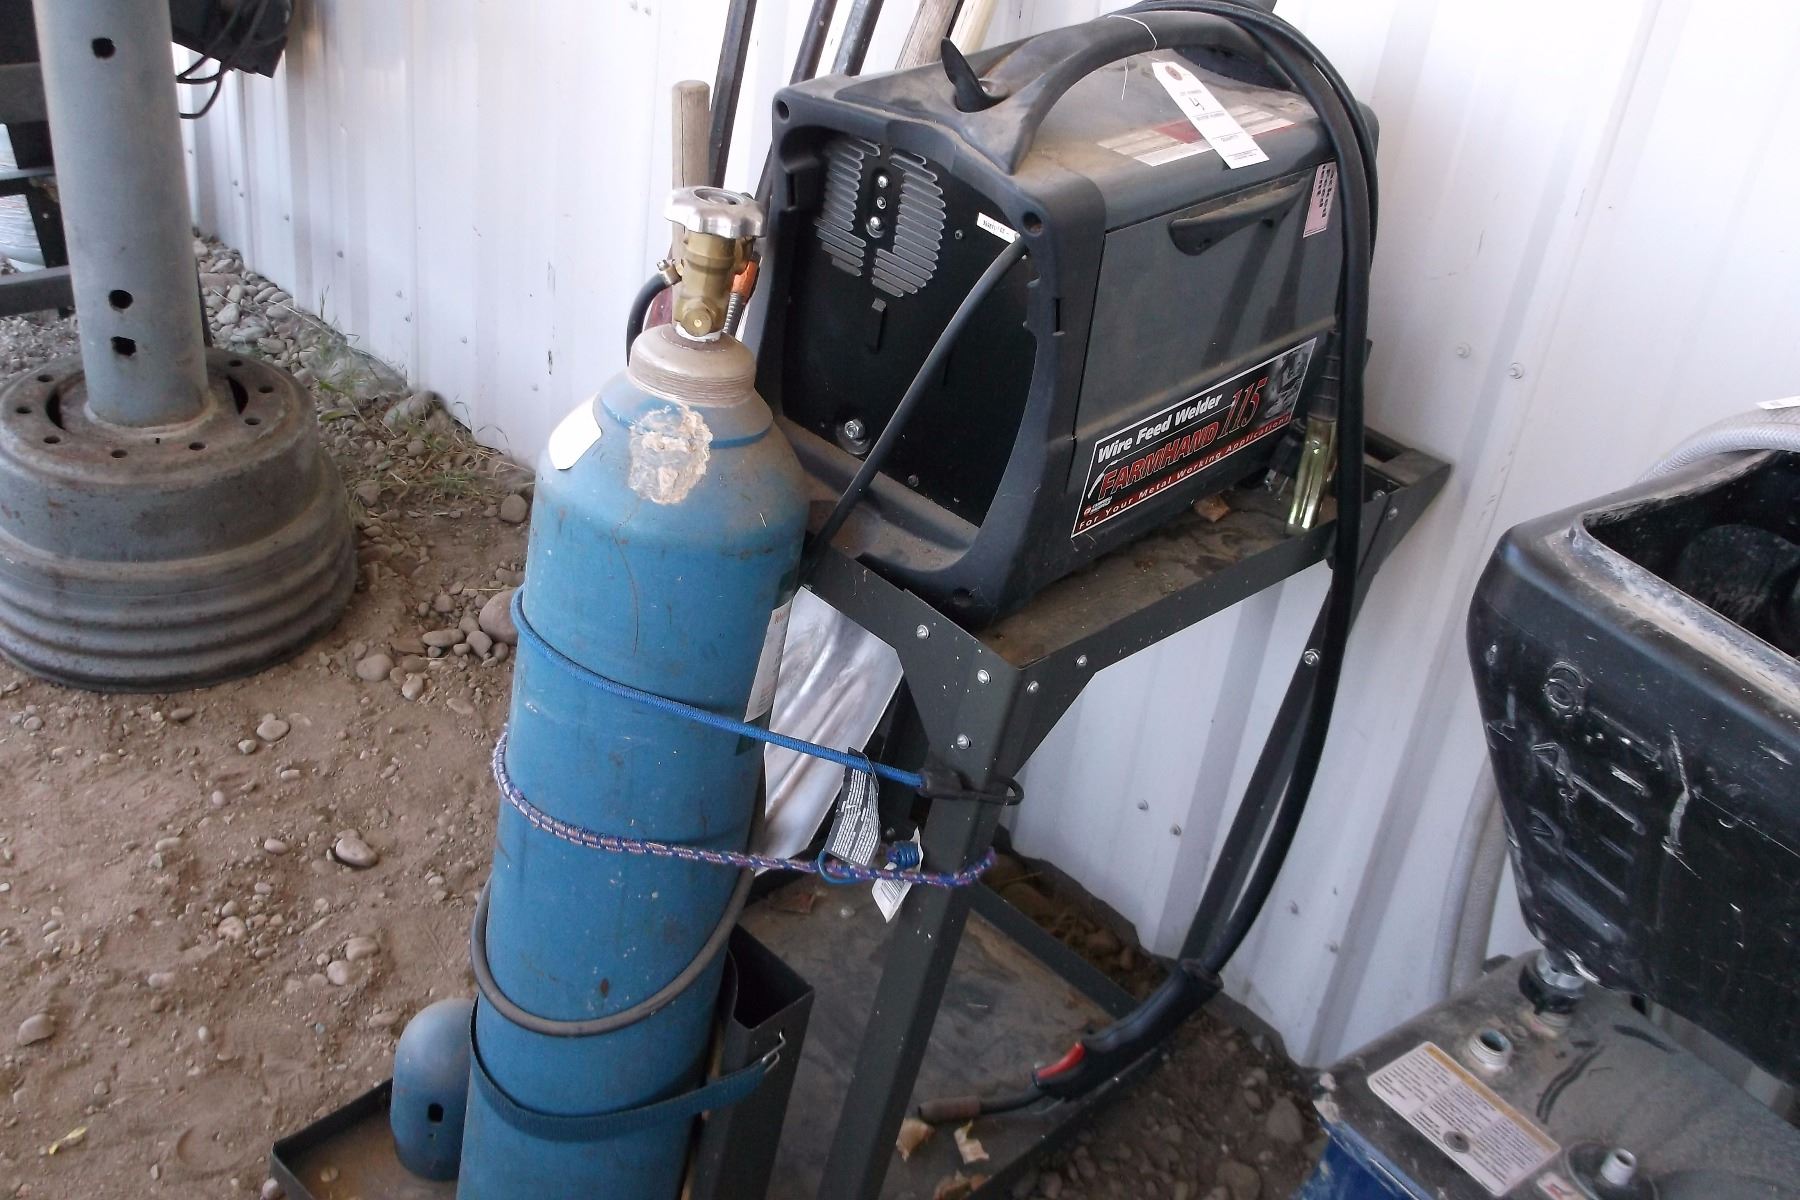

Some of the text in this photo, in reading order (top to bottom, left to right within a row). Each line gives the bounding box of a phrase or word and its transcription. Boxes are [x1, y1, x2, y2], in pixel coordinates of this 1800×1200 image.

[1079, 515, 1099, 530] For
[1105, 497, 1133, 516] Your
[1138, 476, 1172, 499] Metal
[1176, 452, 1221, 480] Working
[1225, 415, 1290, 453] Applications
[1097, 394, 1223, 463] Wire Feed Welder
[1098, 376, 1269, 501] FARMHAND 115
